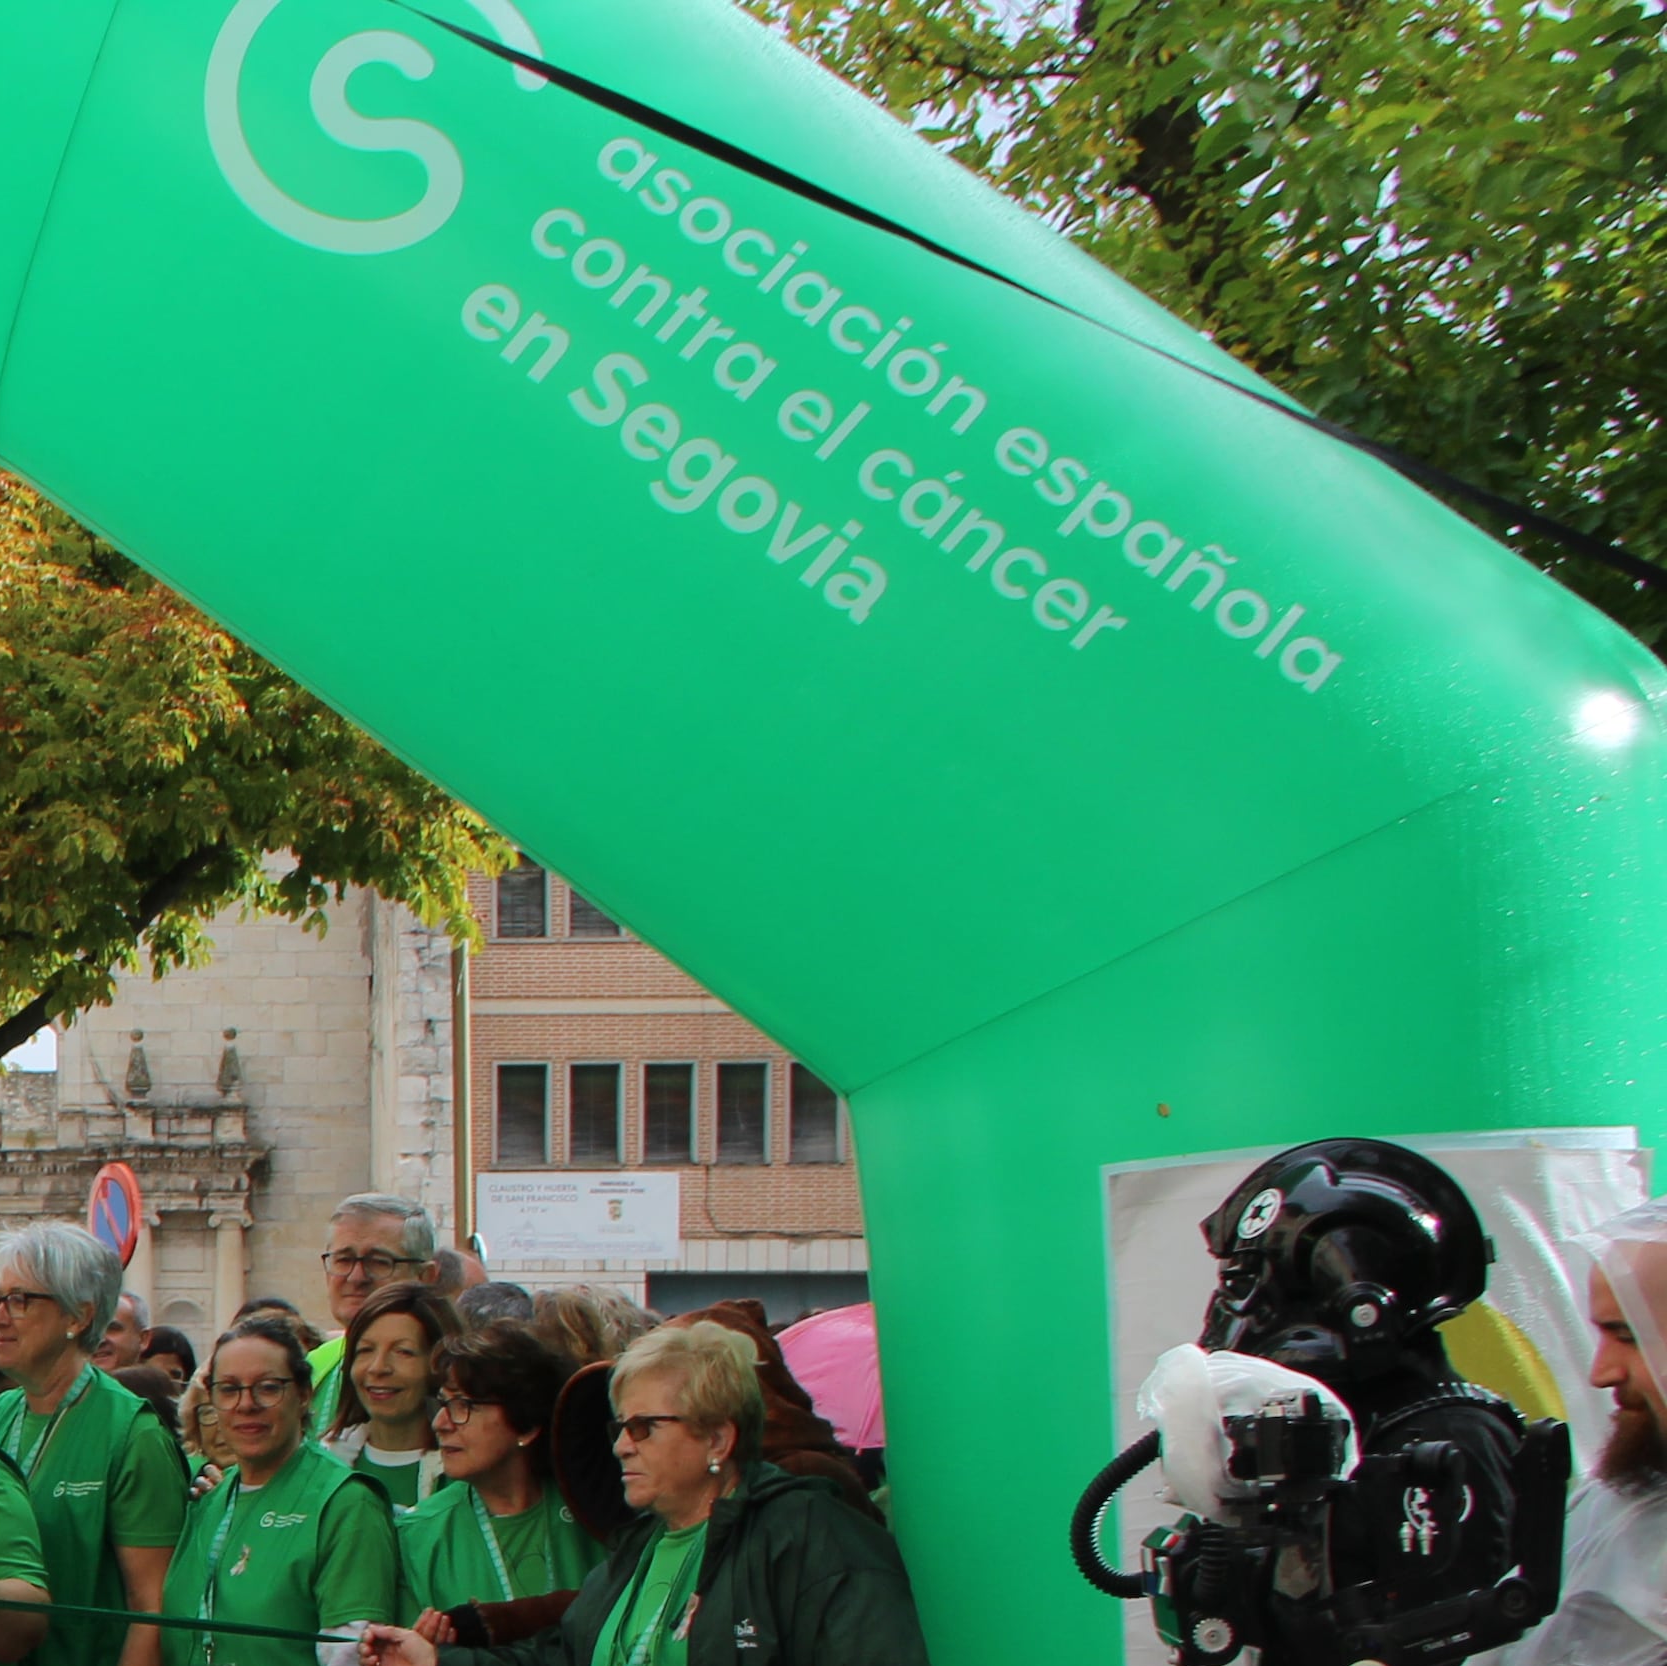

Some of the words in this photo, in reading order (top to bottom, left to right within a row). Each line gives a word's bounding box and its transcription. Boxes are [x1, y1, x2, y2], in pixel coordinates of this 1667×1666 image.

[460, 281, 569, 383] en
[567, 353, 888, 625] Segovia
[528, 203, 777, 402] contra
[777, 386, 872, 461] el
[856, 444, 1132, 652] cáncer
[597, 132, 987, 435] asociación
[992, 422, 1346, 694] española
